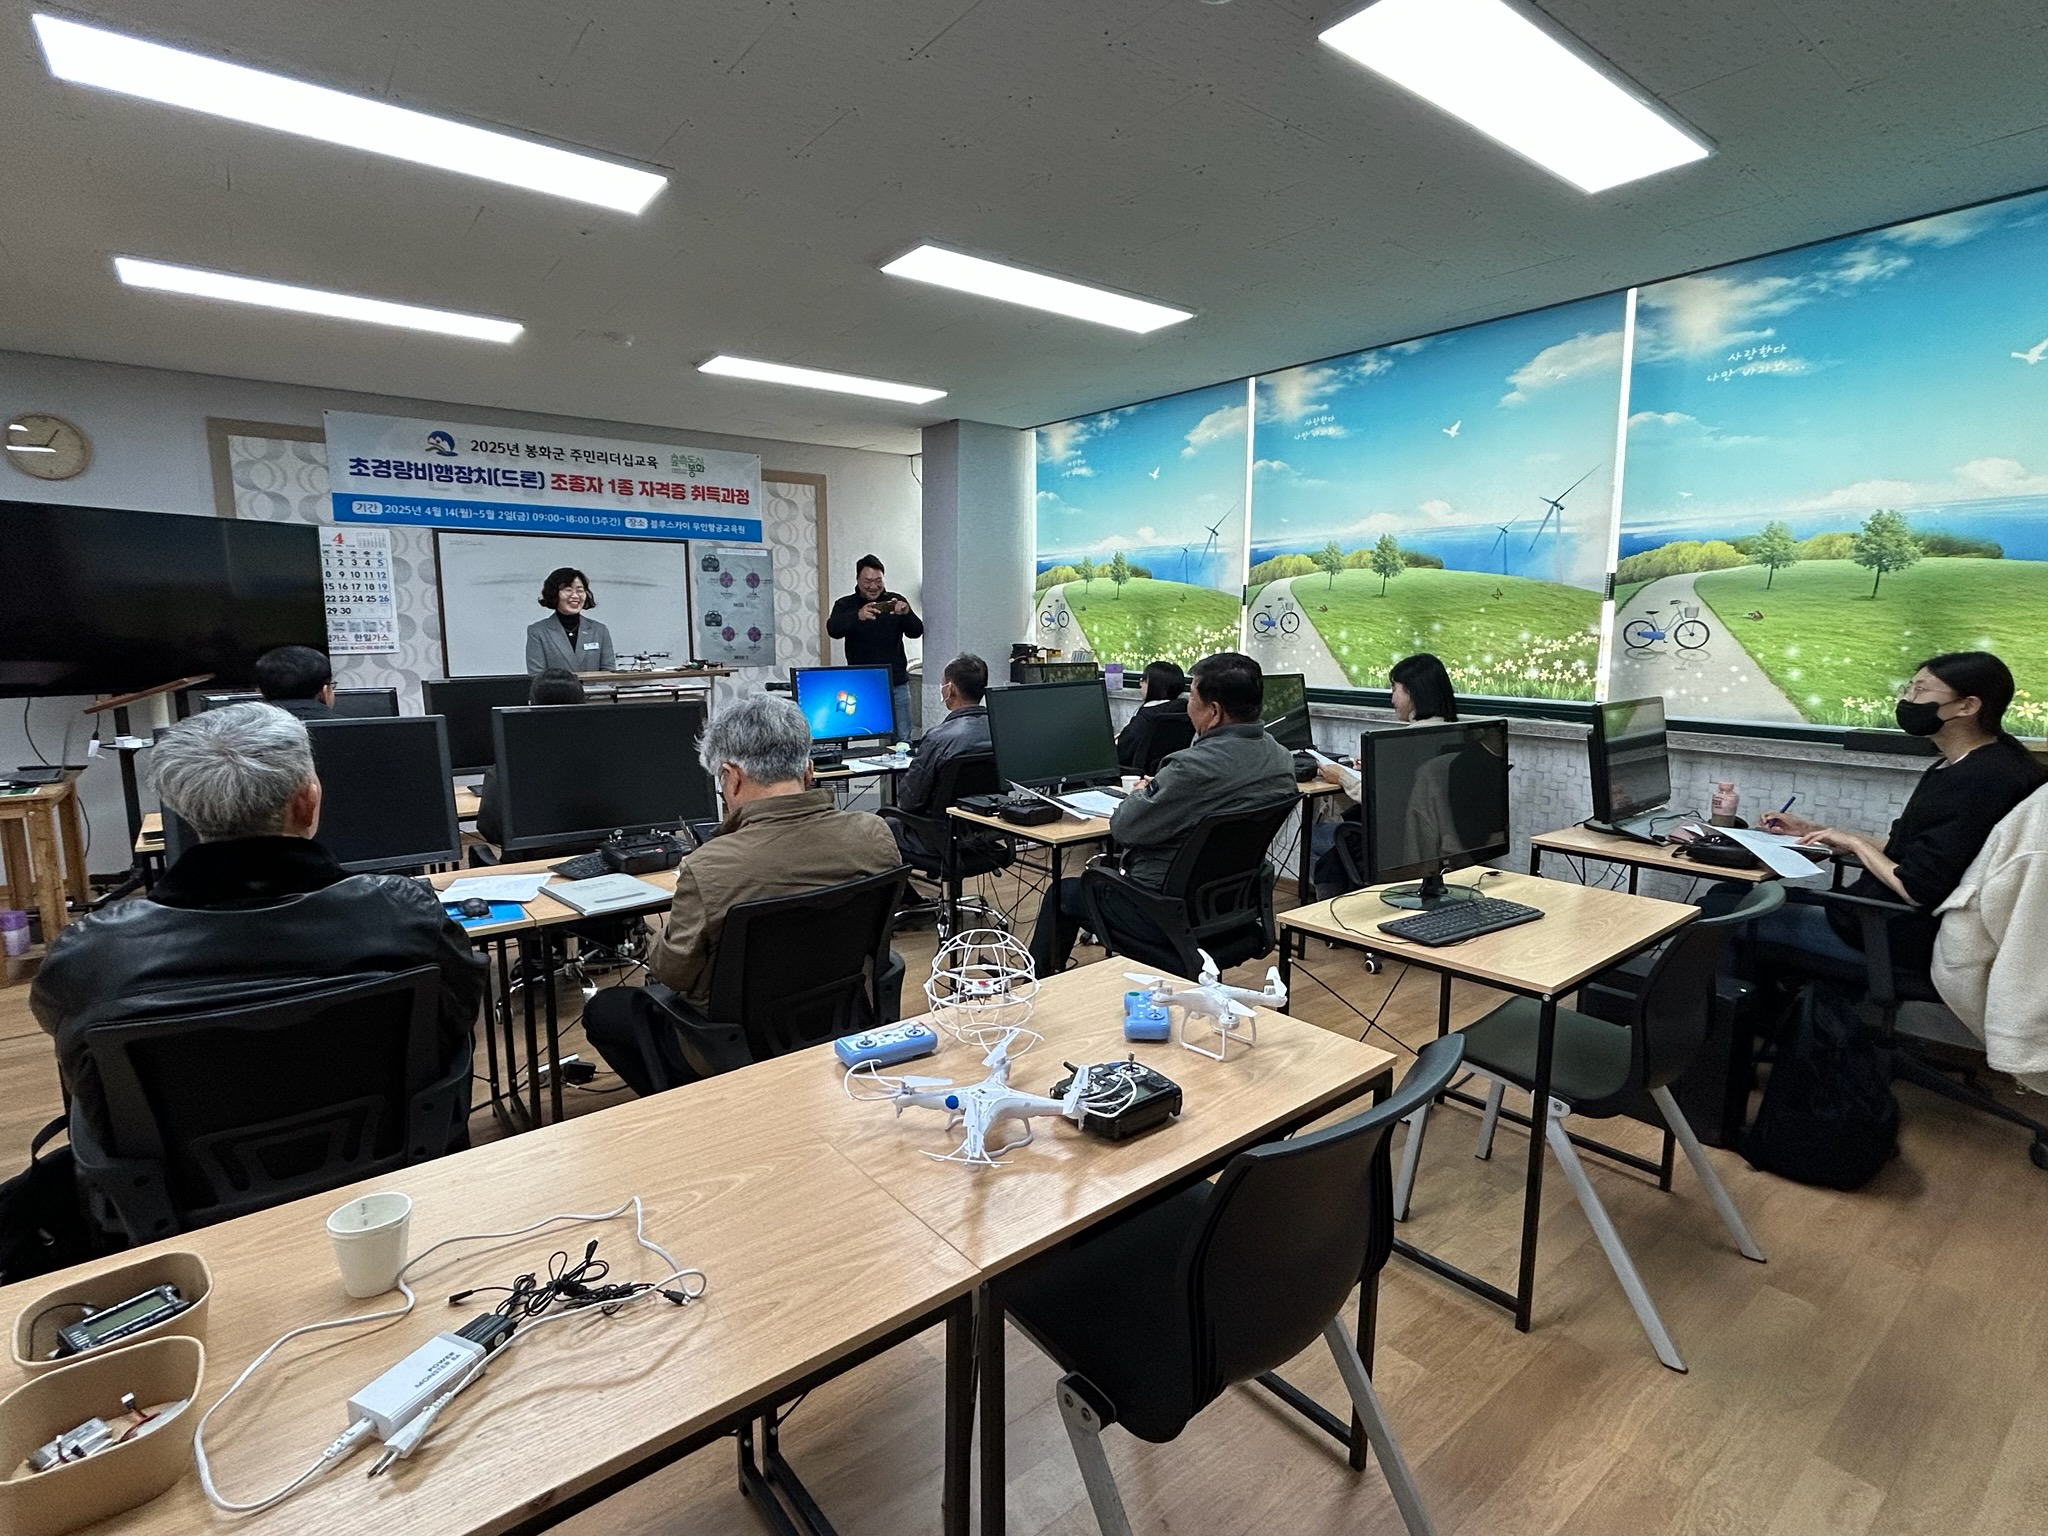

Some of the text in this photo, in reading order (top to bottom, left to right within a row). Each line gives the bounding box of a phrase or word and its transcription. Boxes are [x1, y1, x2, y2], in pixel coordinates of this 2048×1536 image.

[1728, 343, 1787, 361] 사랑한다
[470, 439, 658, 469] 2025년 봉화군 주민리더십교육
[348, 457, 750, 506] 초경량비행장치(드론) 조종자 1종 자격증 취득과정
[357, 502, 378, 513] 기간
[385, 504, 422, 517] 2025년
[425, 507, 442, 518] 4월
[498, 511, 529, 521] 2일(금)
[532, 512, 590, 525] 09:00~18:00
[591, 515, 621, 527] (3주간)
[627, 518, 646, 528] 장소
[650, 519, 690, 531] 블루스카이
[333, 532, 345, 545] 4
[378, 559, 384, 567] 5
[350, 571, 360, 579] 10
[364, 571, 374, 579] 11
[377, 571, 387, 579] 12
[378, 583, 388, 591] 19
[352, 595, 363, 603] 24
[365, 595, 377, 603] 25
[379, 595, 390, 603] 26
[326, 607, 351, 615] 29 30
[353, 633, 390, 642] 한일가스
[427, 1352, 455, 1372] POWER
[414, 1361, 451, 1388] MONSTER
